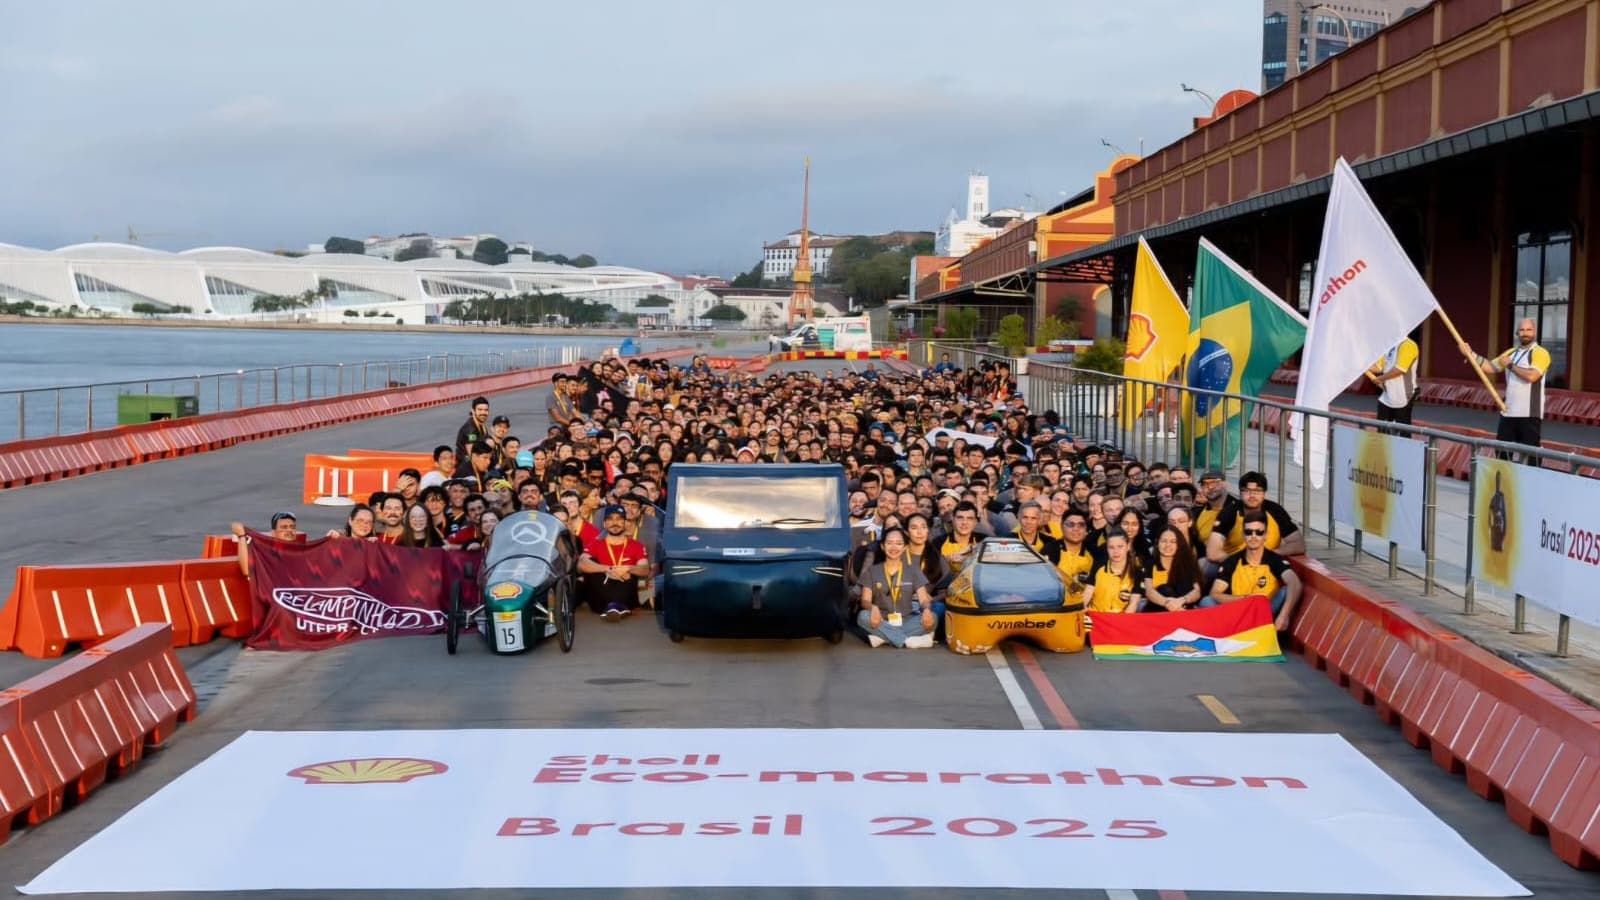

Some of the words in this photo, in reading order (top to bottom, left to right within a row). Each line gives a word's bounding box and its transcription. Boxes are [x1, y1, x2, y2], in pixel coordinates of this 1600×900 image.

[1541, 518, 1566, 555] Brasil
[1568, 527, 1600, 566] 2025
[502, 627, 516, 645] 15
[546, 754, 721, 766] Shell
[533, 767, 1308, 789] Eco-marathon
[496, 814, 803, 837] Brasil
[869, 816, 1168, 839] 2025
